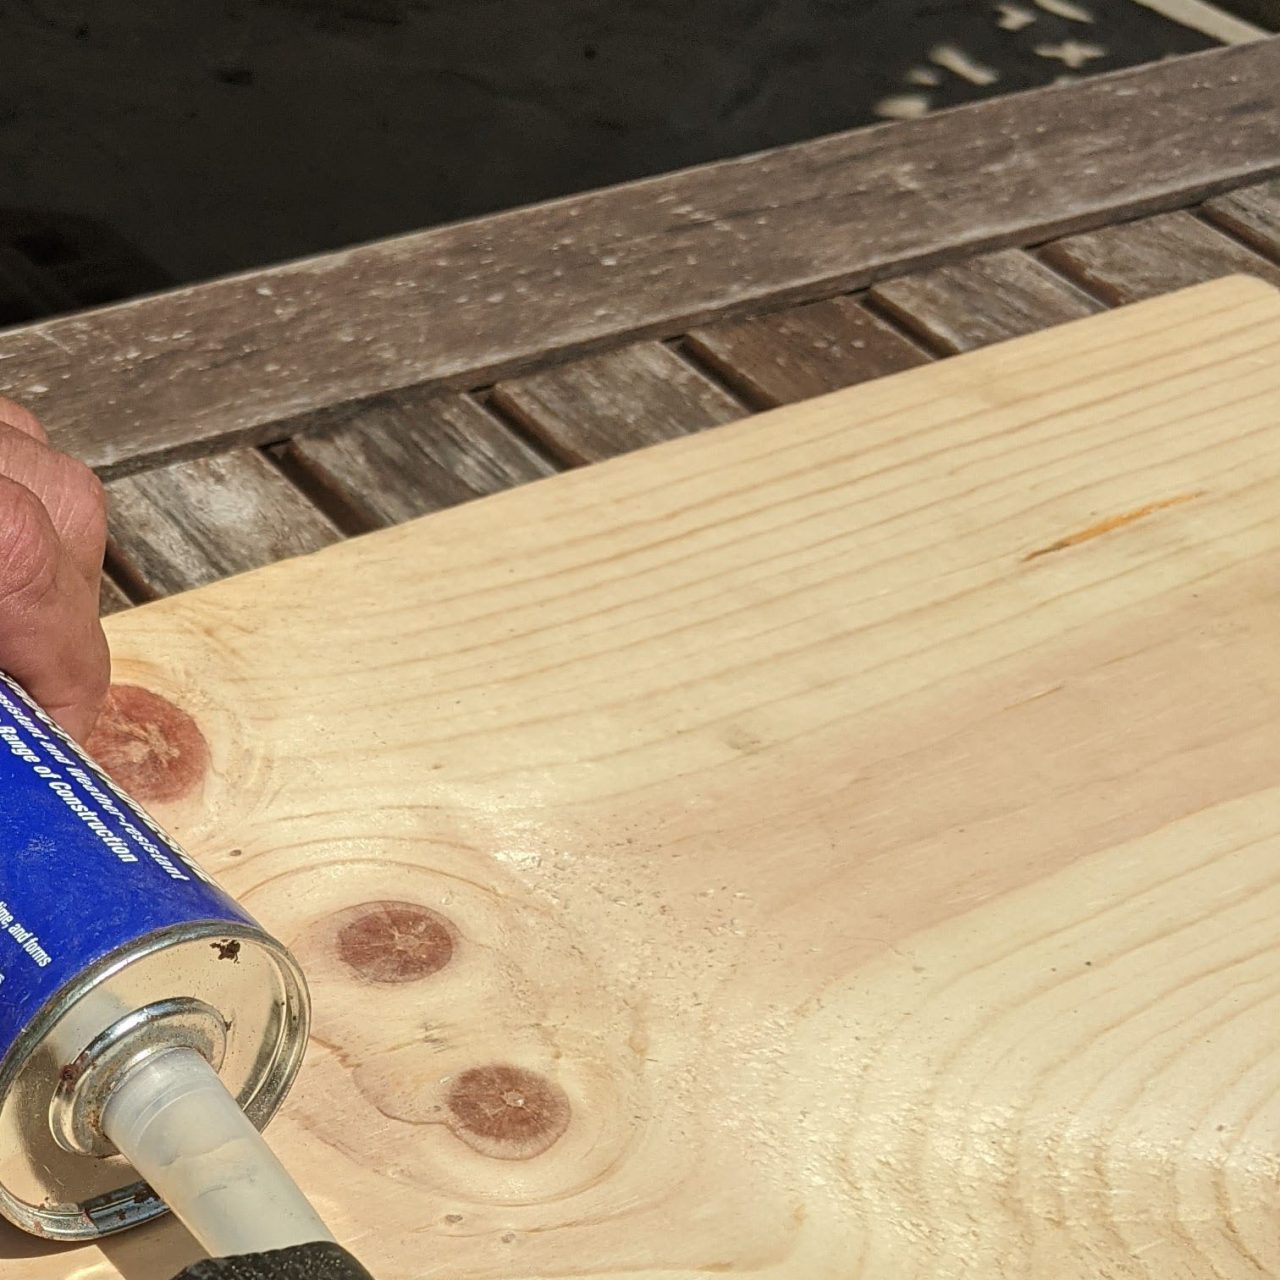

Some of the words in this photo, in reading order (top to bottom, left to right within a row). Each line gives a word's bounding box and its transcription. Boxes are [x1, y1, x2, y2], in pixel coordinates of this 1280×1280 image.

[33, 765, 61, 778] of
[50, 781, 136, 861] Construction
[40, 741, 75, 765] and
[67, 768, 188, 879] Weather-resistant
[8, 923, 32, 942] and
[23, 937, 51, 966] forms
